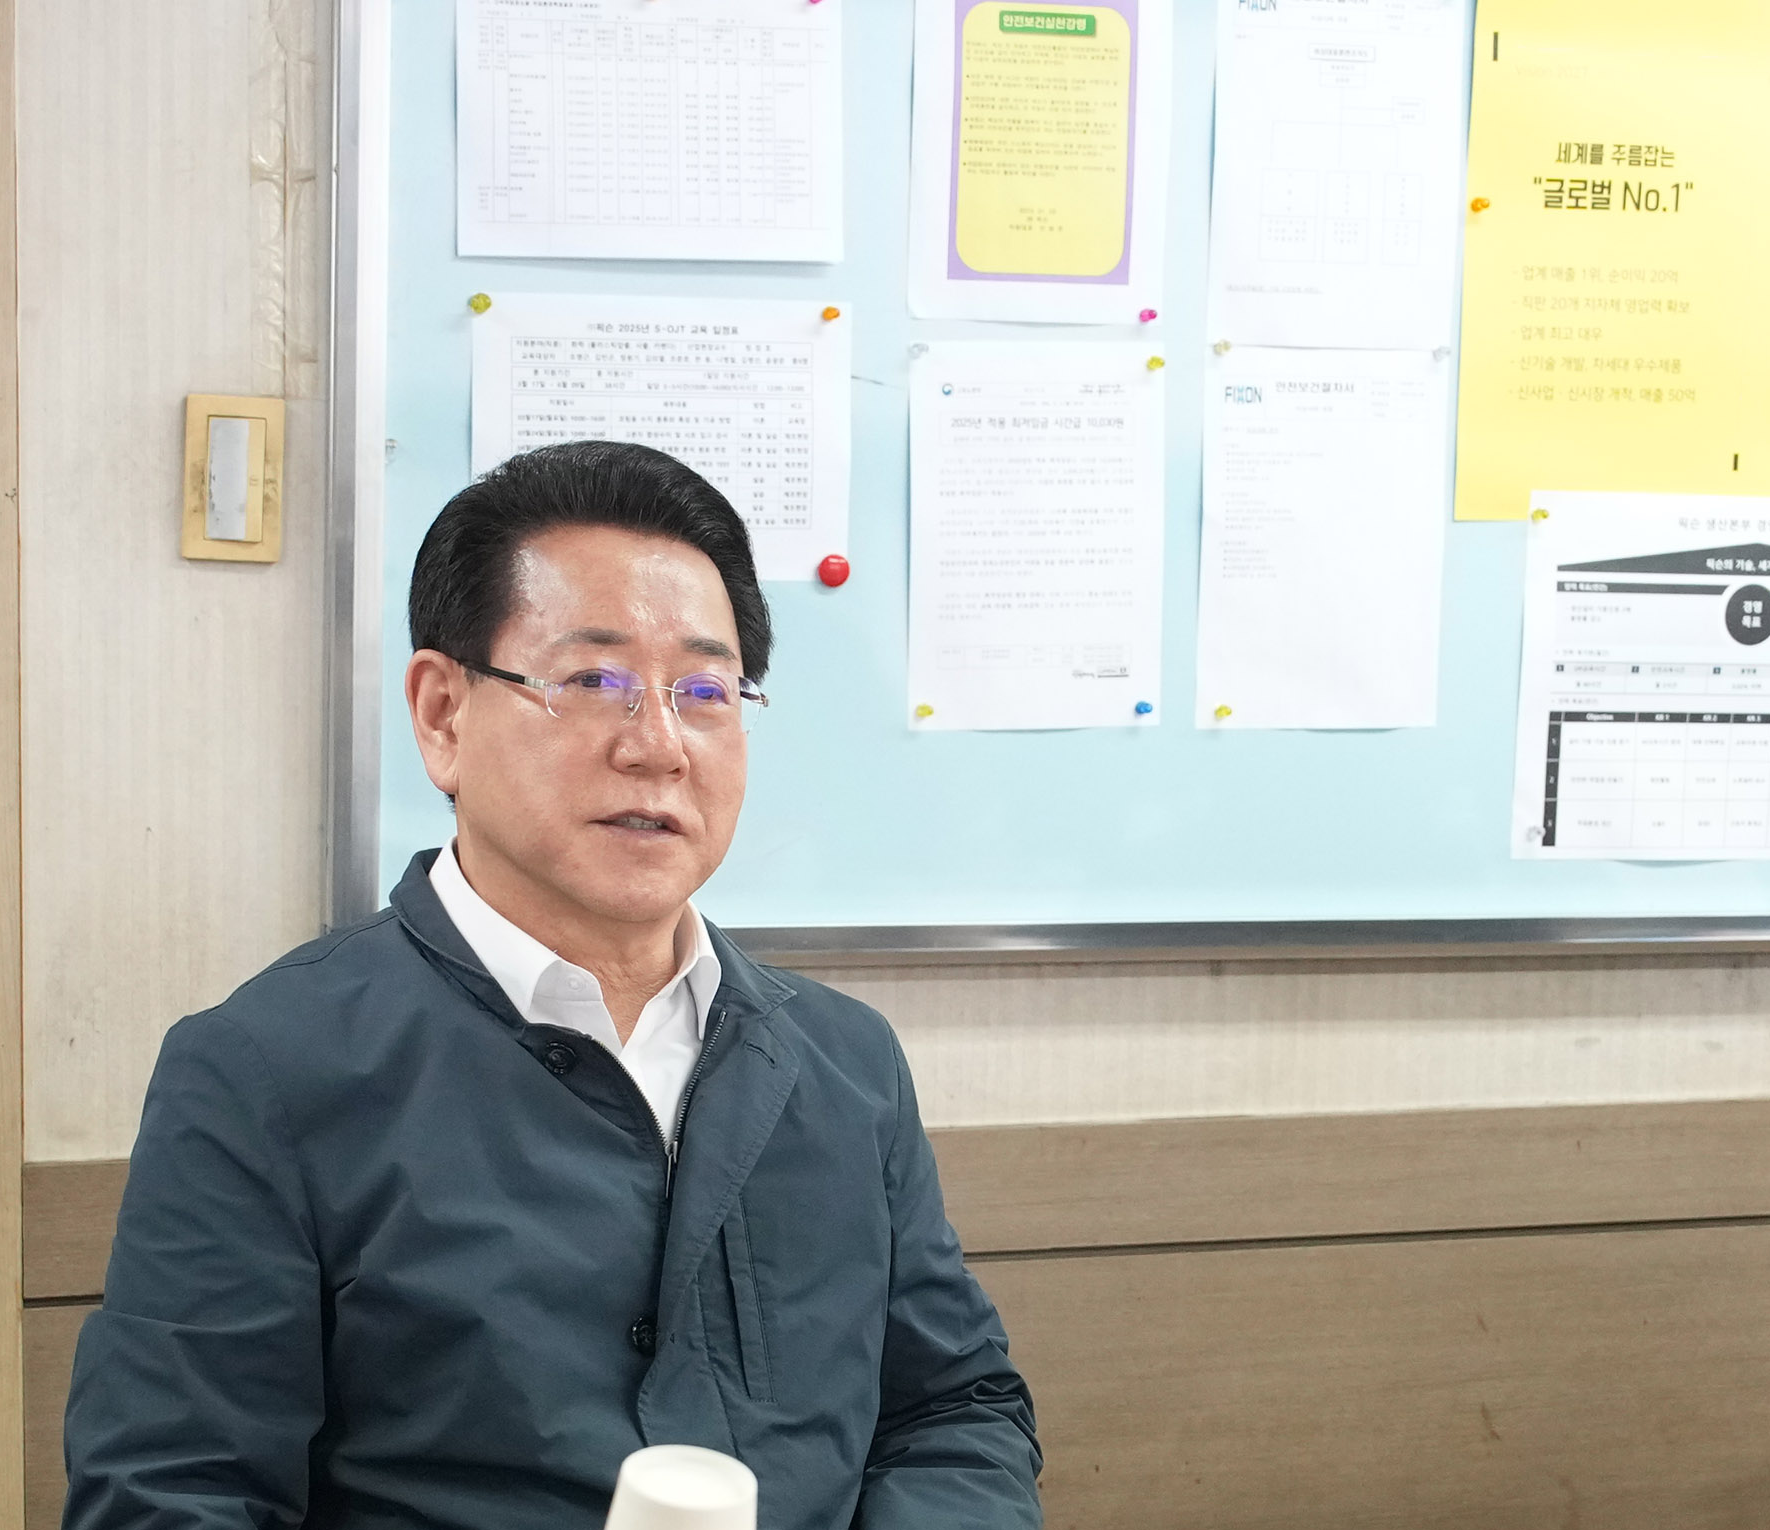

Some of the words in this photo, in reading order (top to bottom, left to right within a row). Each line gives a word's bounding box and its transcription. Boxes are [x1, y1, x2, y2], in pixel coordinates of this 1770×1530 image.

[1555, 142, 1603, 165] 세계를
[1611, 144, 1674, 168] 주름잡는
[618, 323, 649, 334] 2025년
[1224, 385, 1262, 405] FIXON
[951, 416, 982, 430] 2025년
